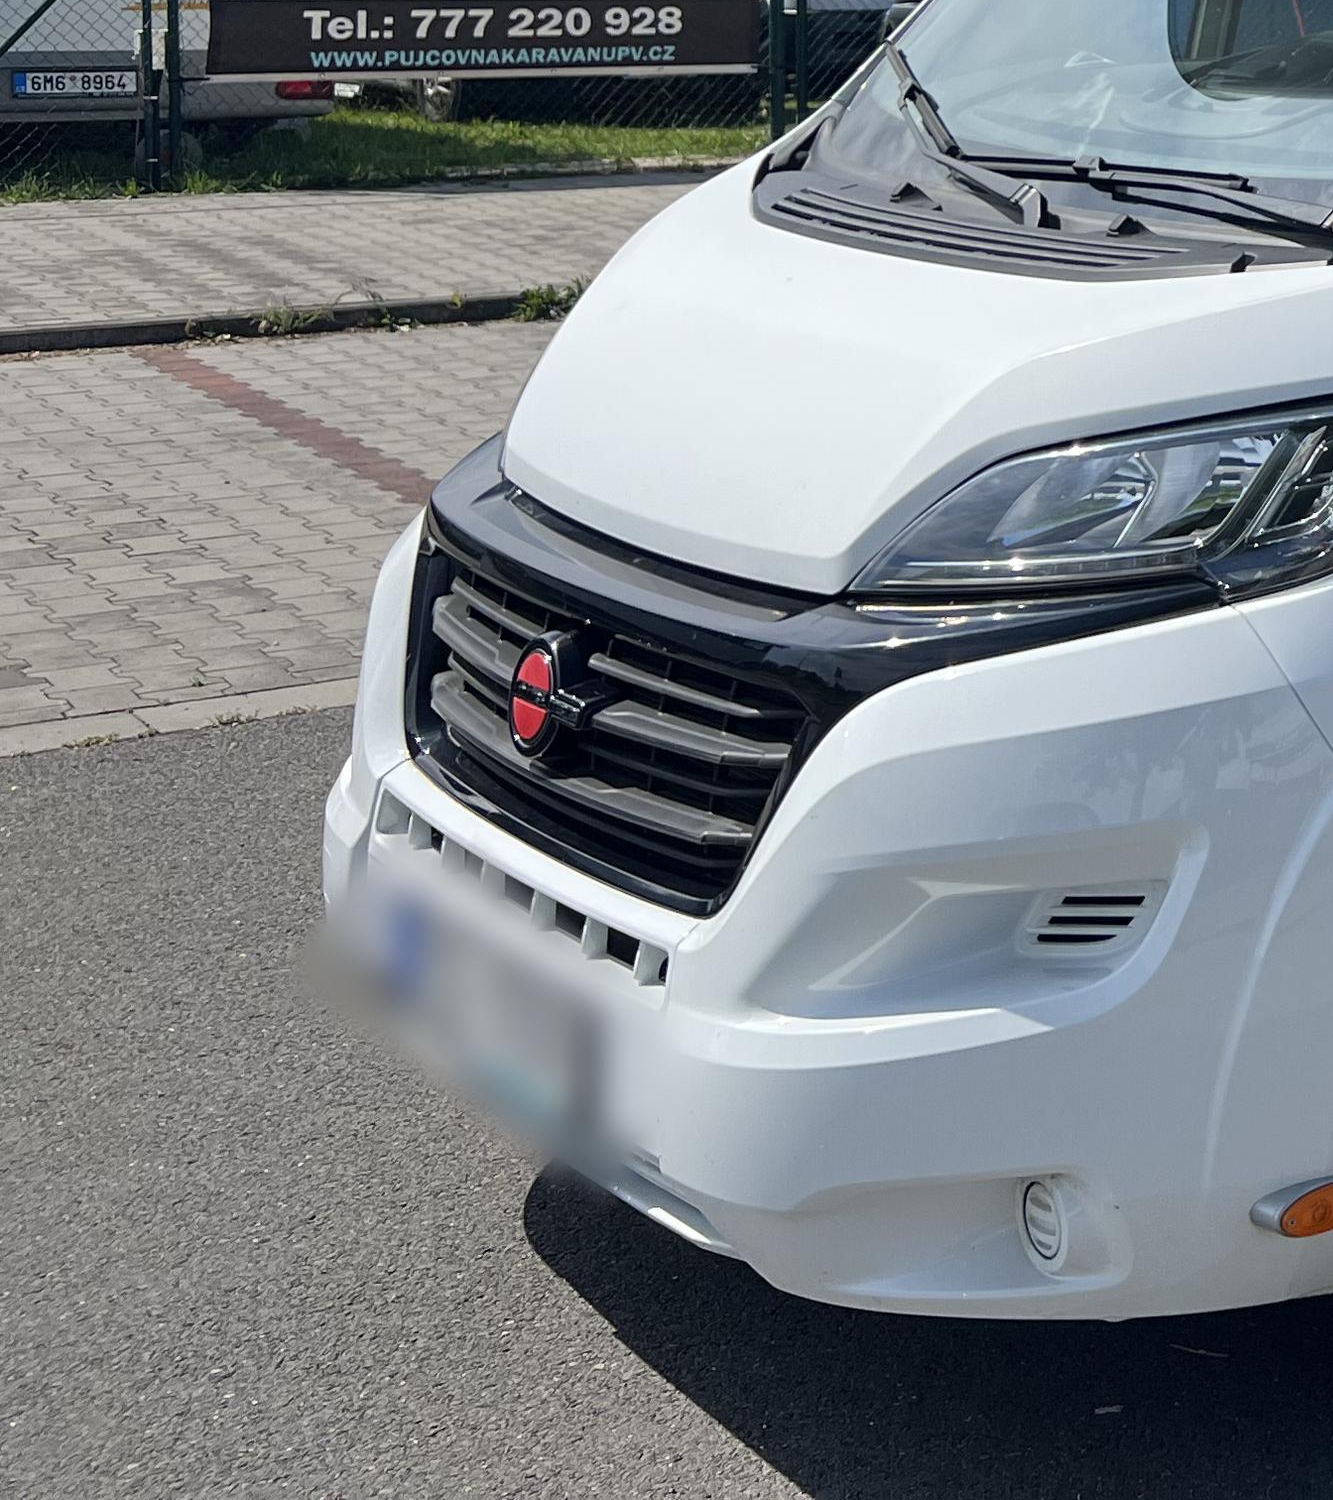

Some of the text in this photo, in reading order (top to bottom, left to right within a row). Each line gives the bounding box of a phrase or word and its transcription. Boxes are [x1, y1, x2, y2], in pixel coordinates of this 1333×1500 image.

[303, 5, 683, 41] Tel.: 777 220 928
[310, 45, 677, 69] WWW.PUJCOVNAKARAVANUPV.CZ
[31, 73, 127, 91] 6M6 8964
